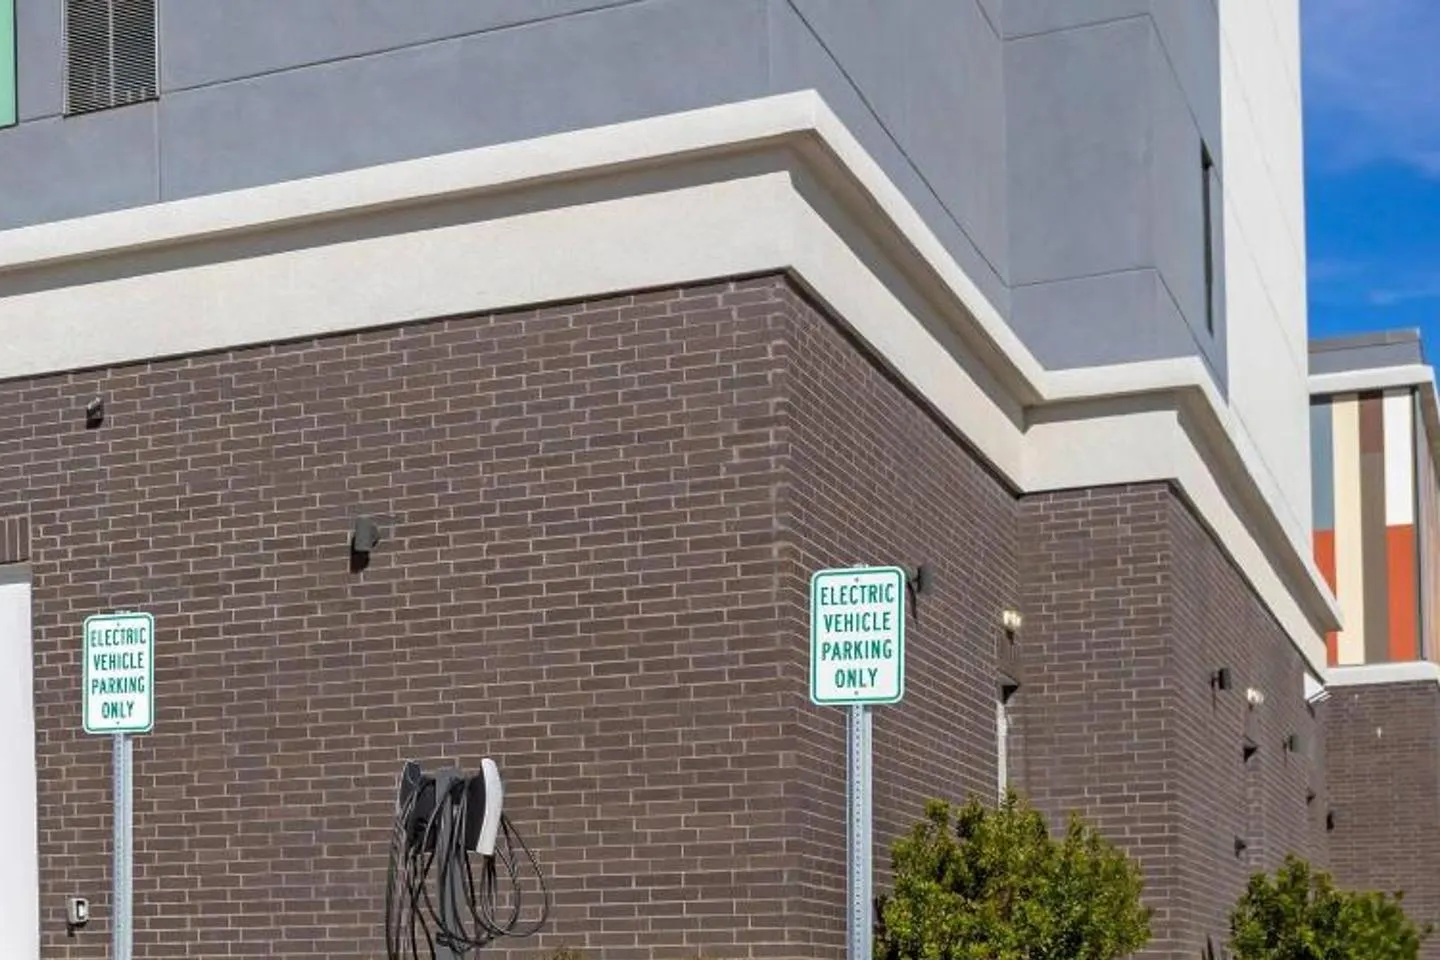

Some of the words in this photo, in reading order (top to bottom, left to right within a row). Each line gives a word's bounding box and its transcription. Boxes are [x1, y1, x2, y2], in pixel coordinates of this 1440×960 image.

[821, 583, 894, 606] ELECTRIC
[823, 612, 891, 632] VEHICLE
[90, 627, 147, 647] ELECTRIC
[822, 639, 893, 661] PARKING
[93, 652, 144, 671] VEHICLE
[91, 676, 145, 695] PARKING
[834, 667, 878, 688] ONLY
[101, 700, 135, 719] ONLY
